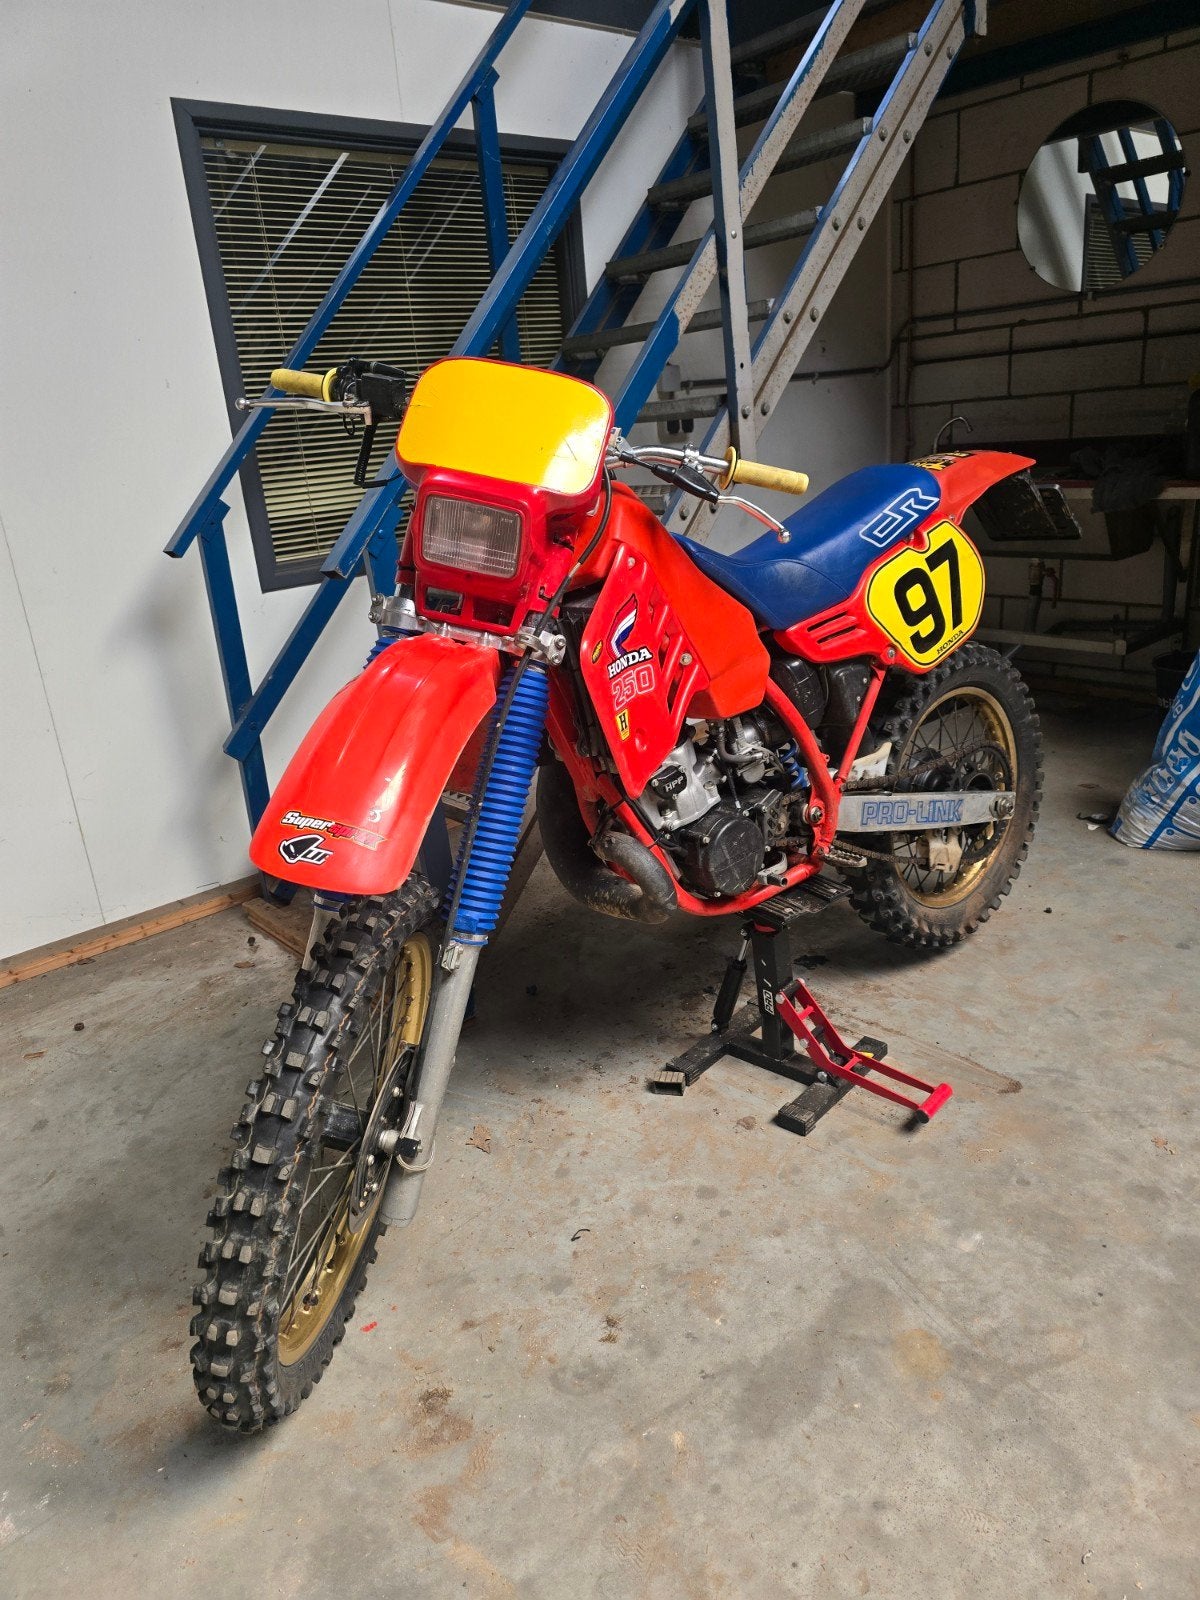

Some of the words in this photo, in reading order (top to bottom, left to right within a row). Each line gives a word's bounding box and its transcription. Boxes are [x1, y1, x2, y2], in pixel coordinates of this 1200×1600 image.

[893, 537, 963, 655] 97
[936, 629, 965, 655] HONDA
[607, 647, 653, 679] HONDA
[611, 664, 656, 711] 250
[664, 775, 684, 793] HPP
[860, 799, 964, 826] PRO-LINK
